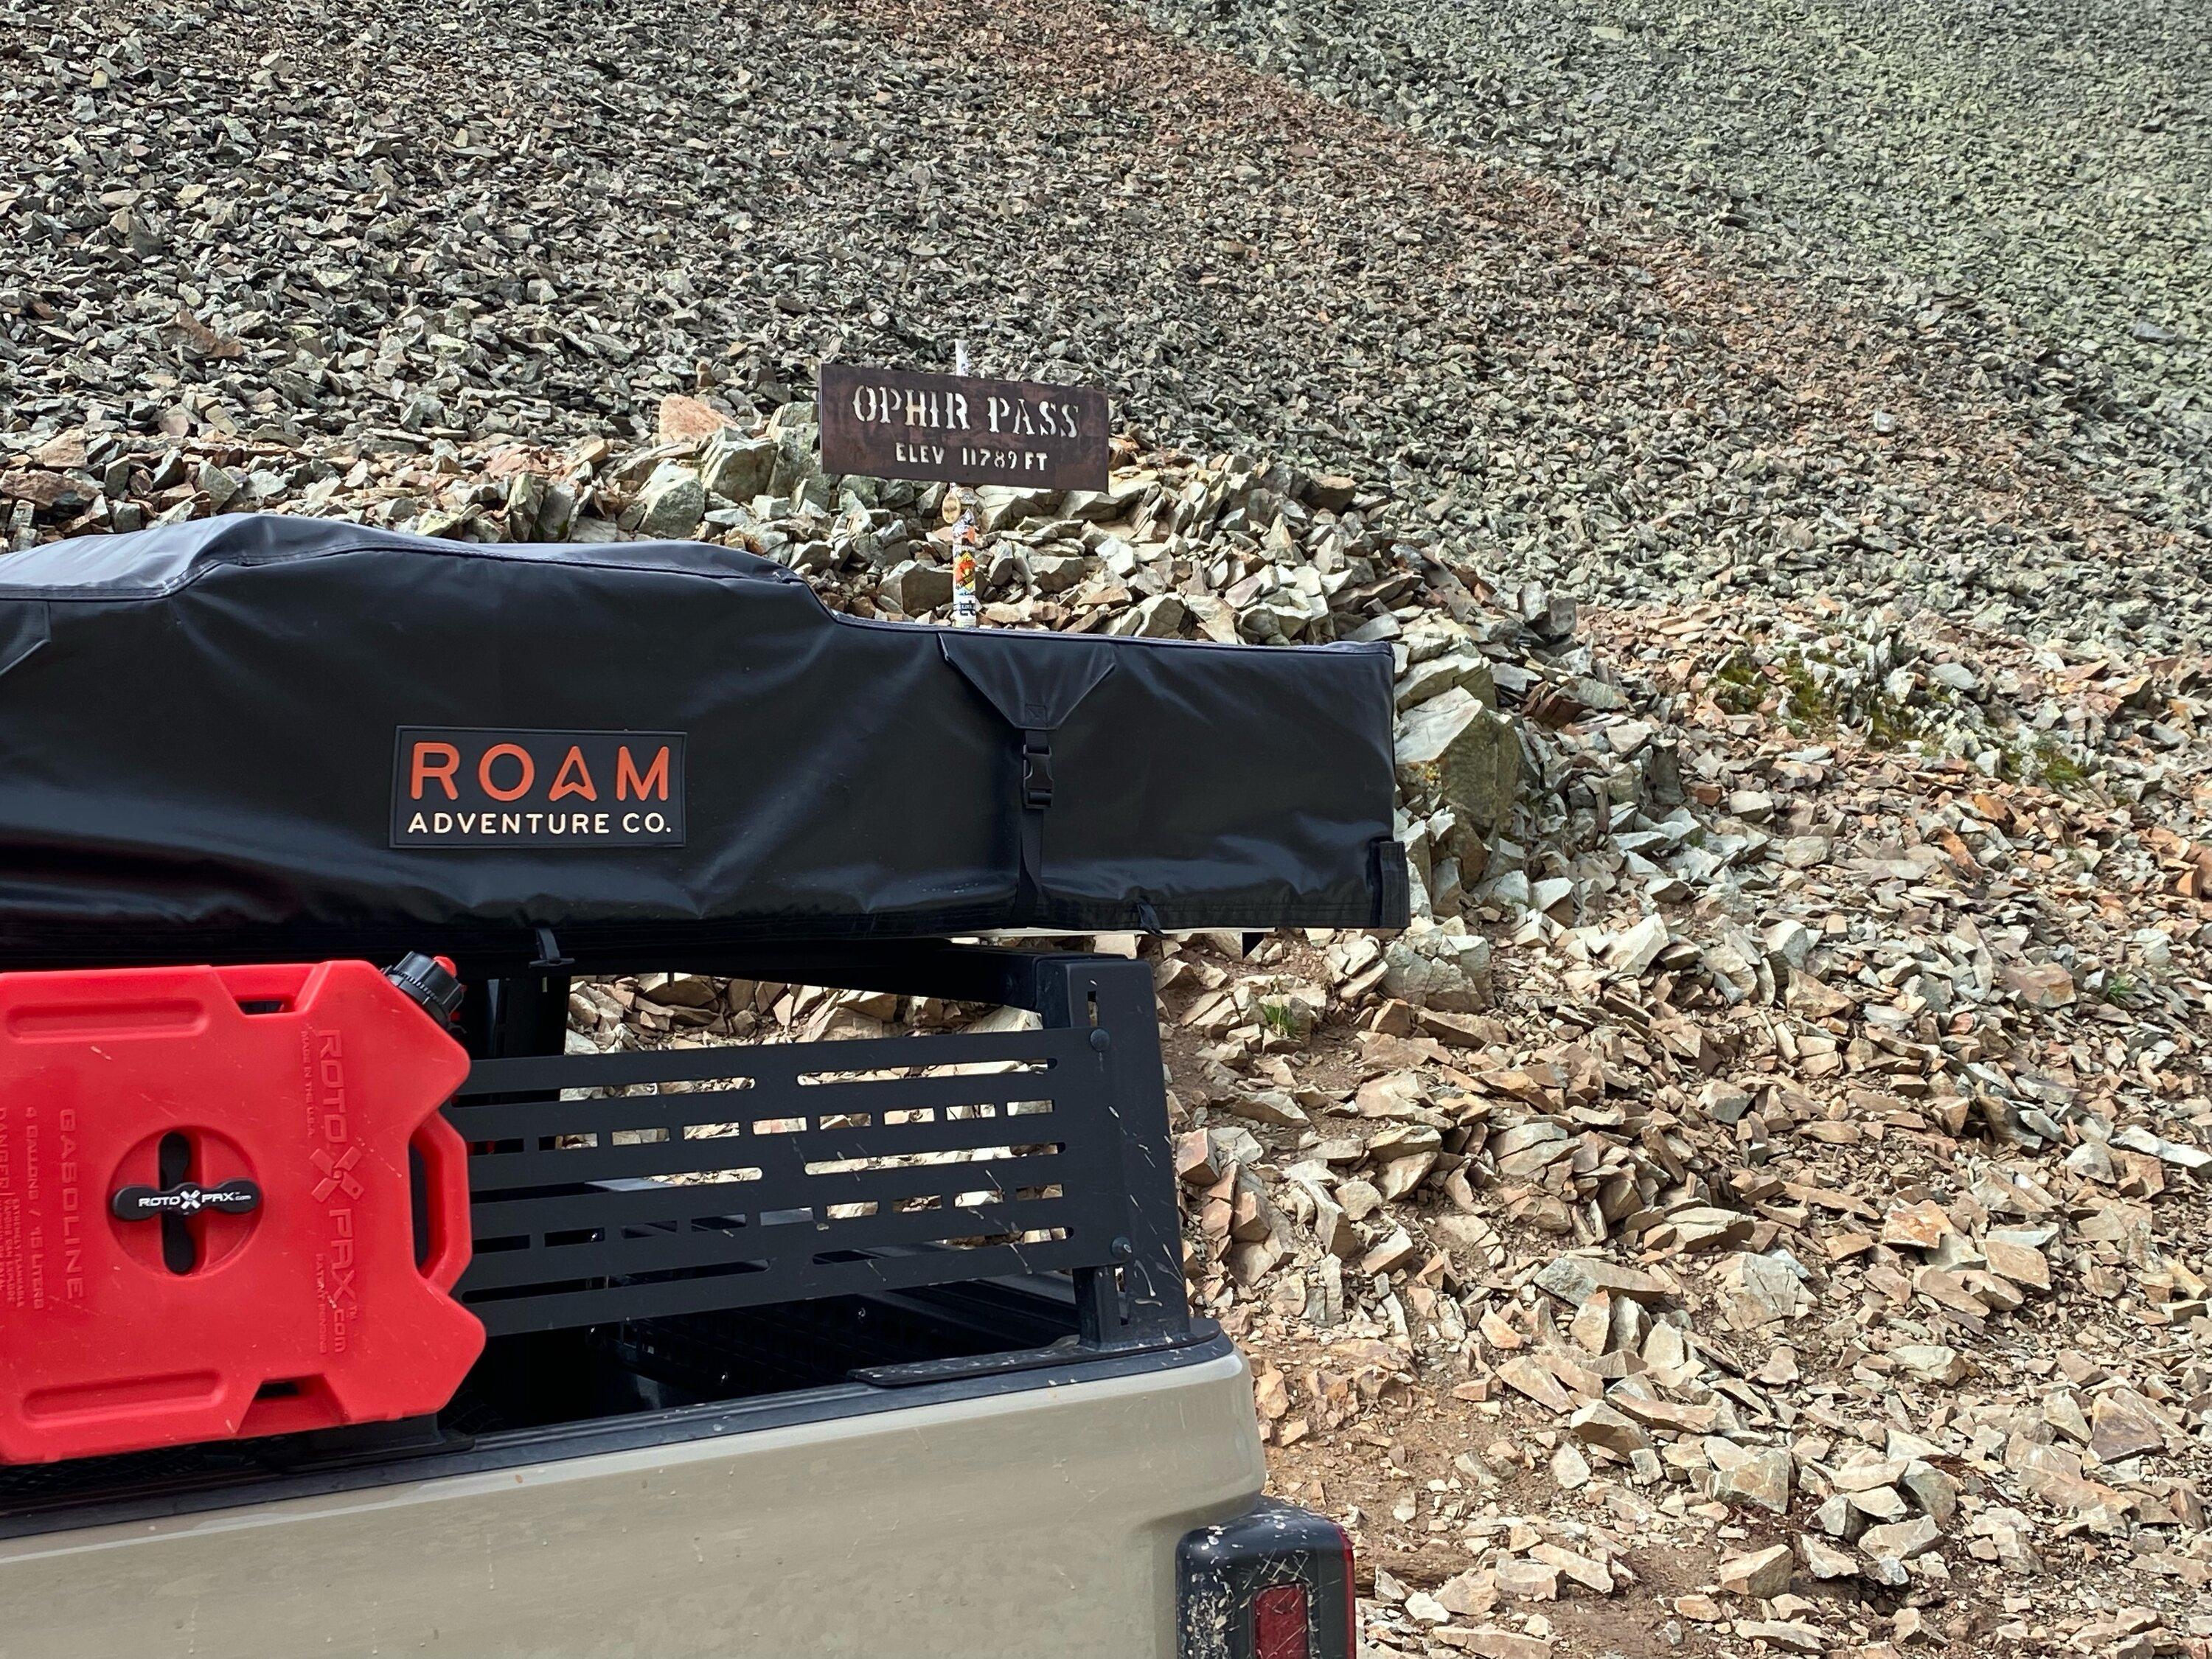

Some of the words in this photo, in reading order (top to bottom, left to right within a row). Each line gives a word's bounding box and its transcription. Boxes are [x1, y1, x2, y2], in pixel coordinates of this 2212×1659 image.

[852, 384, 971, 431] OPHIR
[987, 396, 1079, 439] PASS
[895, 442, 945, 465] ELEV
[961, 447, 1018, 470] 11789
[1024, 451, 1048, 471] FT
[410, 742, 670, 802] ROAM
[407, 812, 611, 835] ADVENTURE
[622, 812, 672, 834] CO.
[301, 1031, 311, 1063] MADE
[304, 1066, 313, 1078] IN
[317, 1029, 349, 1143] ROTO
[305, 1082, 314, 1103] THE
[25, 1106, 38, 1119] 4
[27, 1125, 39, 1200] GALLONS
[60, 1108, 84, 1299] GASOLINE
[138, 1195, 181, 1208] ROTO
[31, 1253, 44, 1310] LITERS
